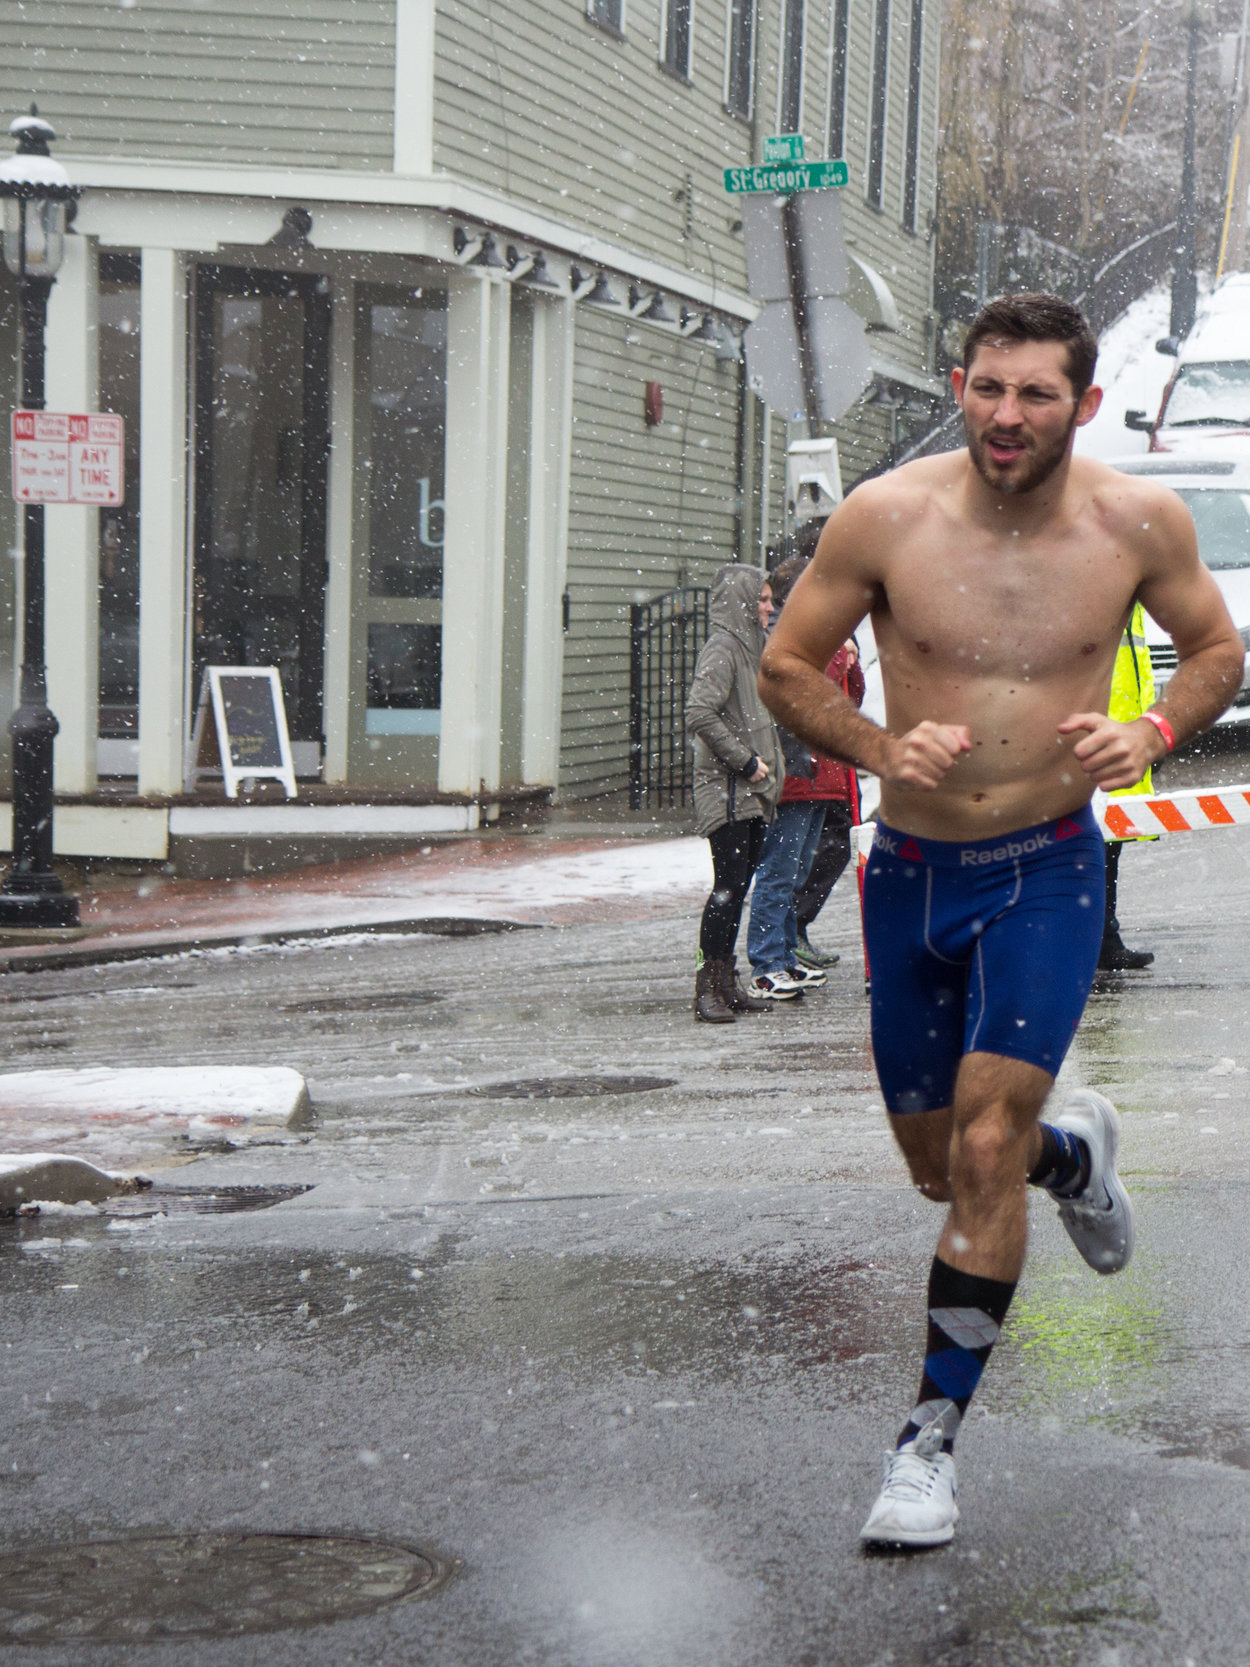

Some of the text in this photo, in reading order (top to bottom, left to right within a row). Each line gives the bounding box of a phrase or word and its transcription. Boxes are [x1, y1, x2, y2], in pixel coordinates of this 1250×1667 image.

[16, 417, 33, 436] NO
[81, 448, 109, 463] ANY
[80, 468, 111, 487] TIME
[961, 832, 1053, 866] Reebok
